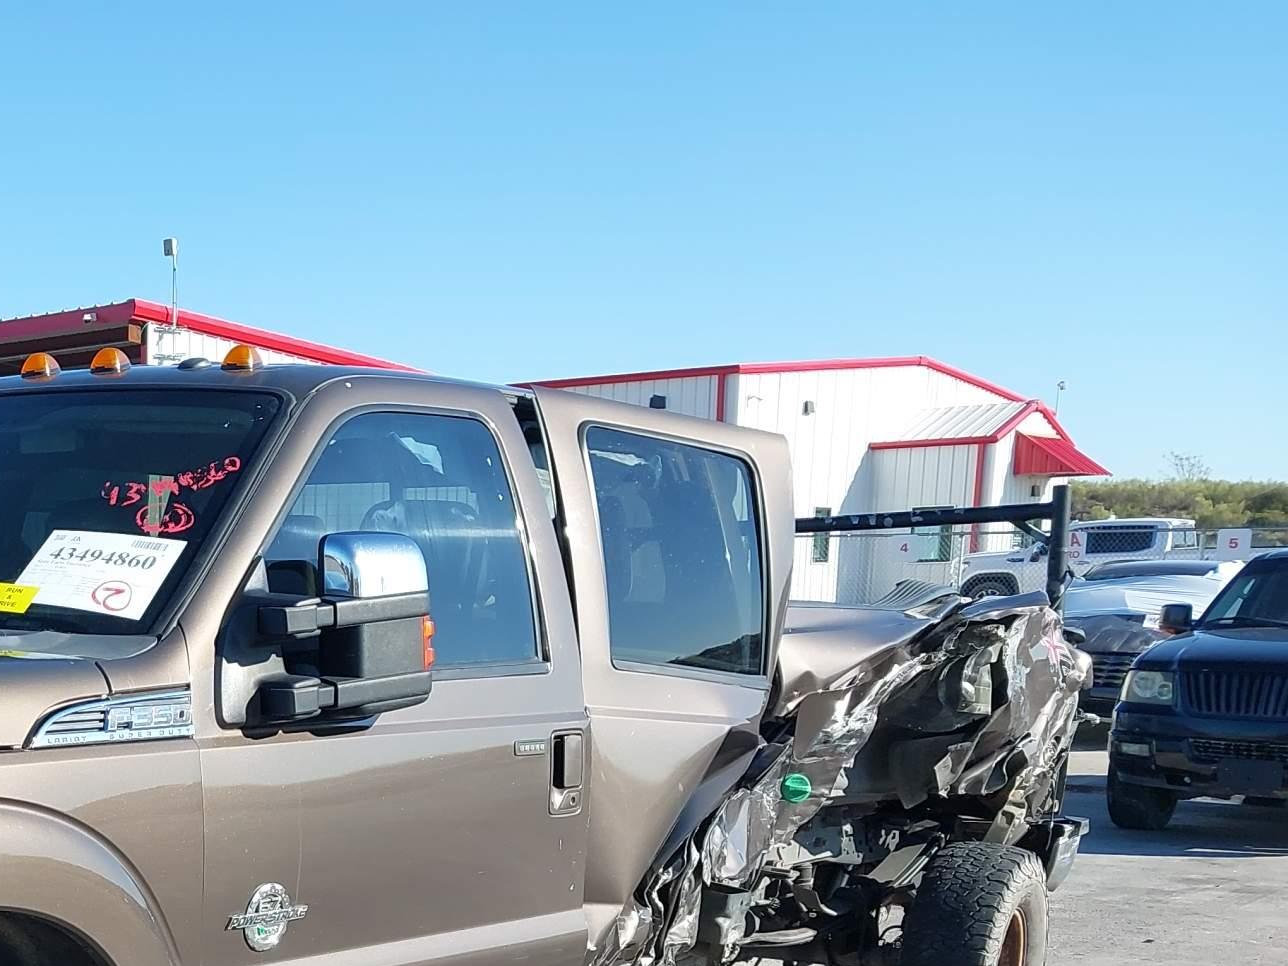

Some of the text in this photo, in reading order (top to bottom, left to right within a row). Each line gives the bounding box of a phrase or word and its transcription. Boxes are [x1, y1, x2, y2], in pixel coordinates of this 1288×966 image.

[899, 542, 909, 553] 4
[1228, 537, 1239, 549] 5
[49, 546, 158, 570] 43494860
